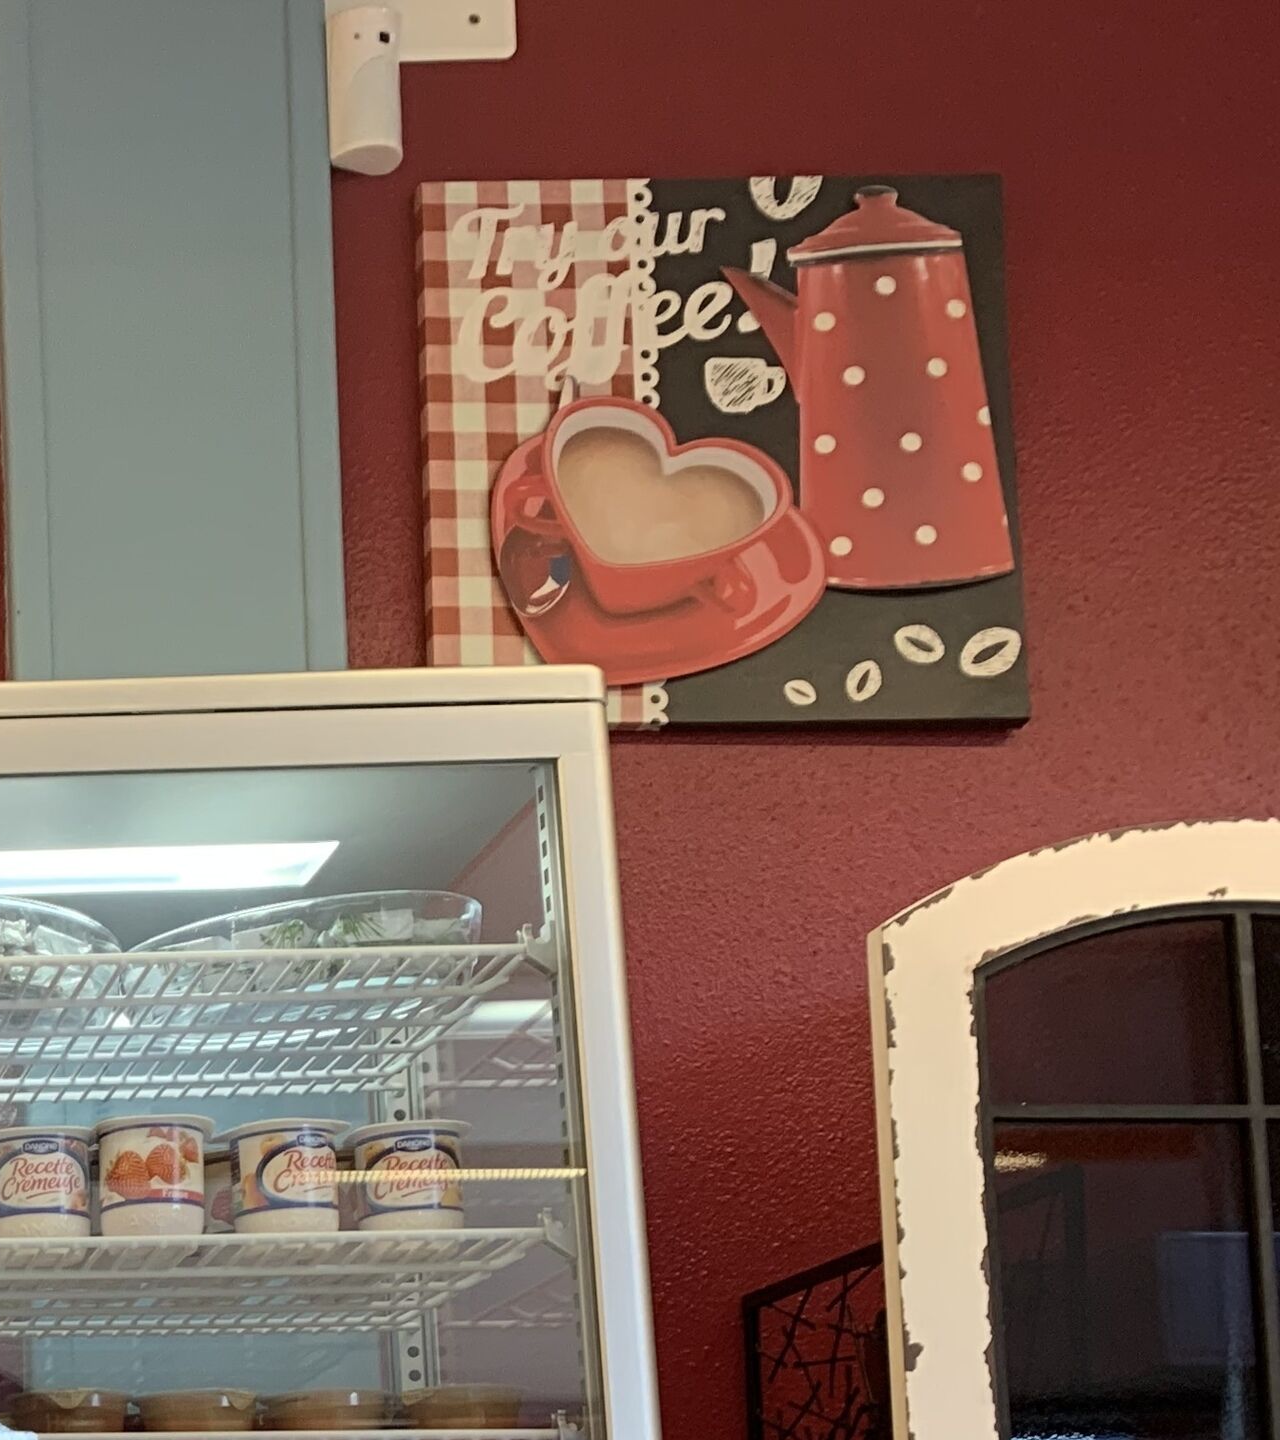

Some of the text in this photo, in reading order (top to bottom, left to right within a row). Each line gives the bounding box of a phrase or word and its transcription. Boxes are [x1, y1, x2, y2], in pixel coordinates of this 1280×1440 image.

[452, 203, 726, 291] Try our
[10, 1157, 74, 1177] Recette
